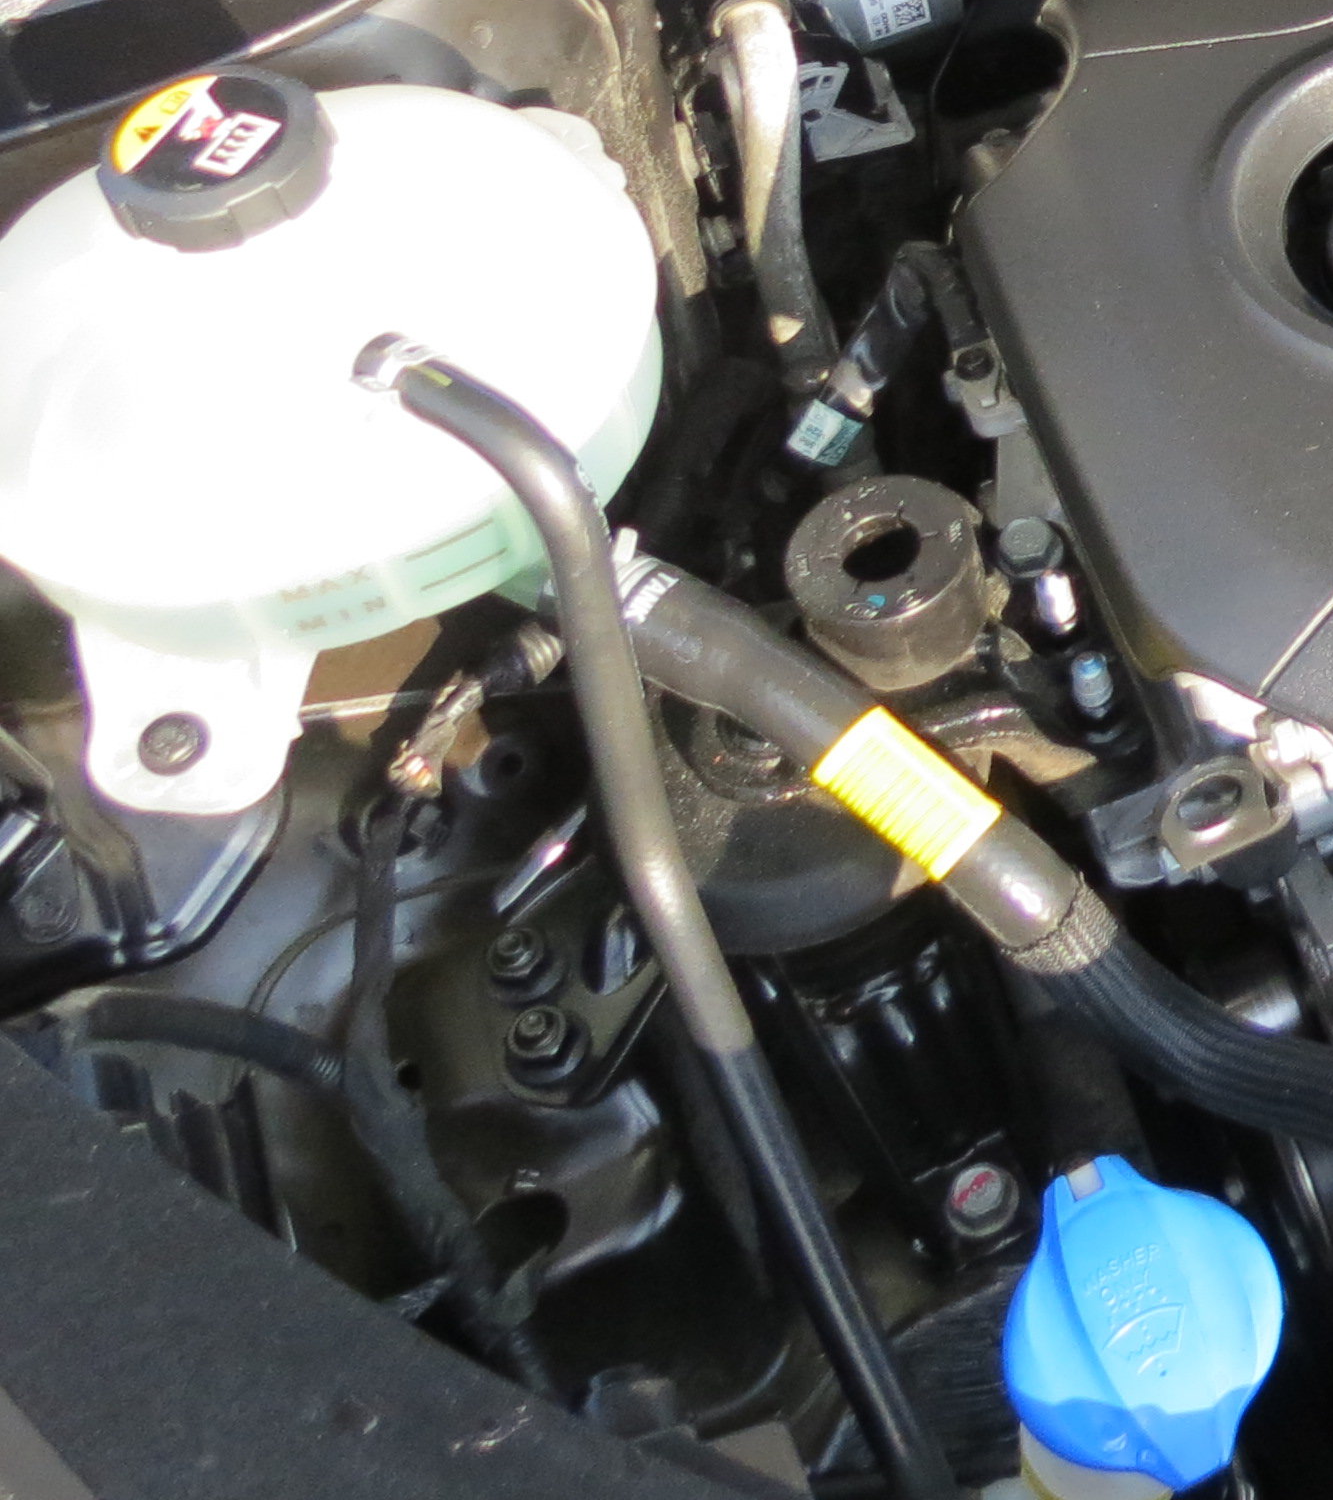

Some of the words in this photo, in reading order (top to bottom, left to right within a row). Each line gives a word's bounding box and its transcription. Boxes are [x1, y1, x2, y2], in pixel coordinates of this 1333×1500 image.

[280, 566, 373, 604] MAX
[624, 572, 680, 623] TANK
[297, 595, 386, 631] MIN
